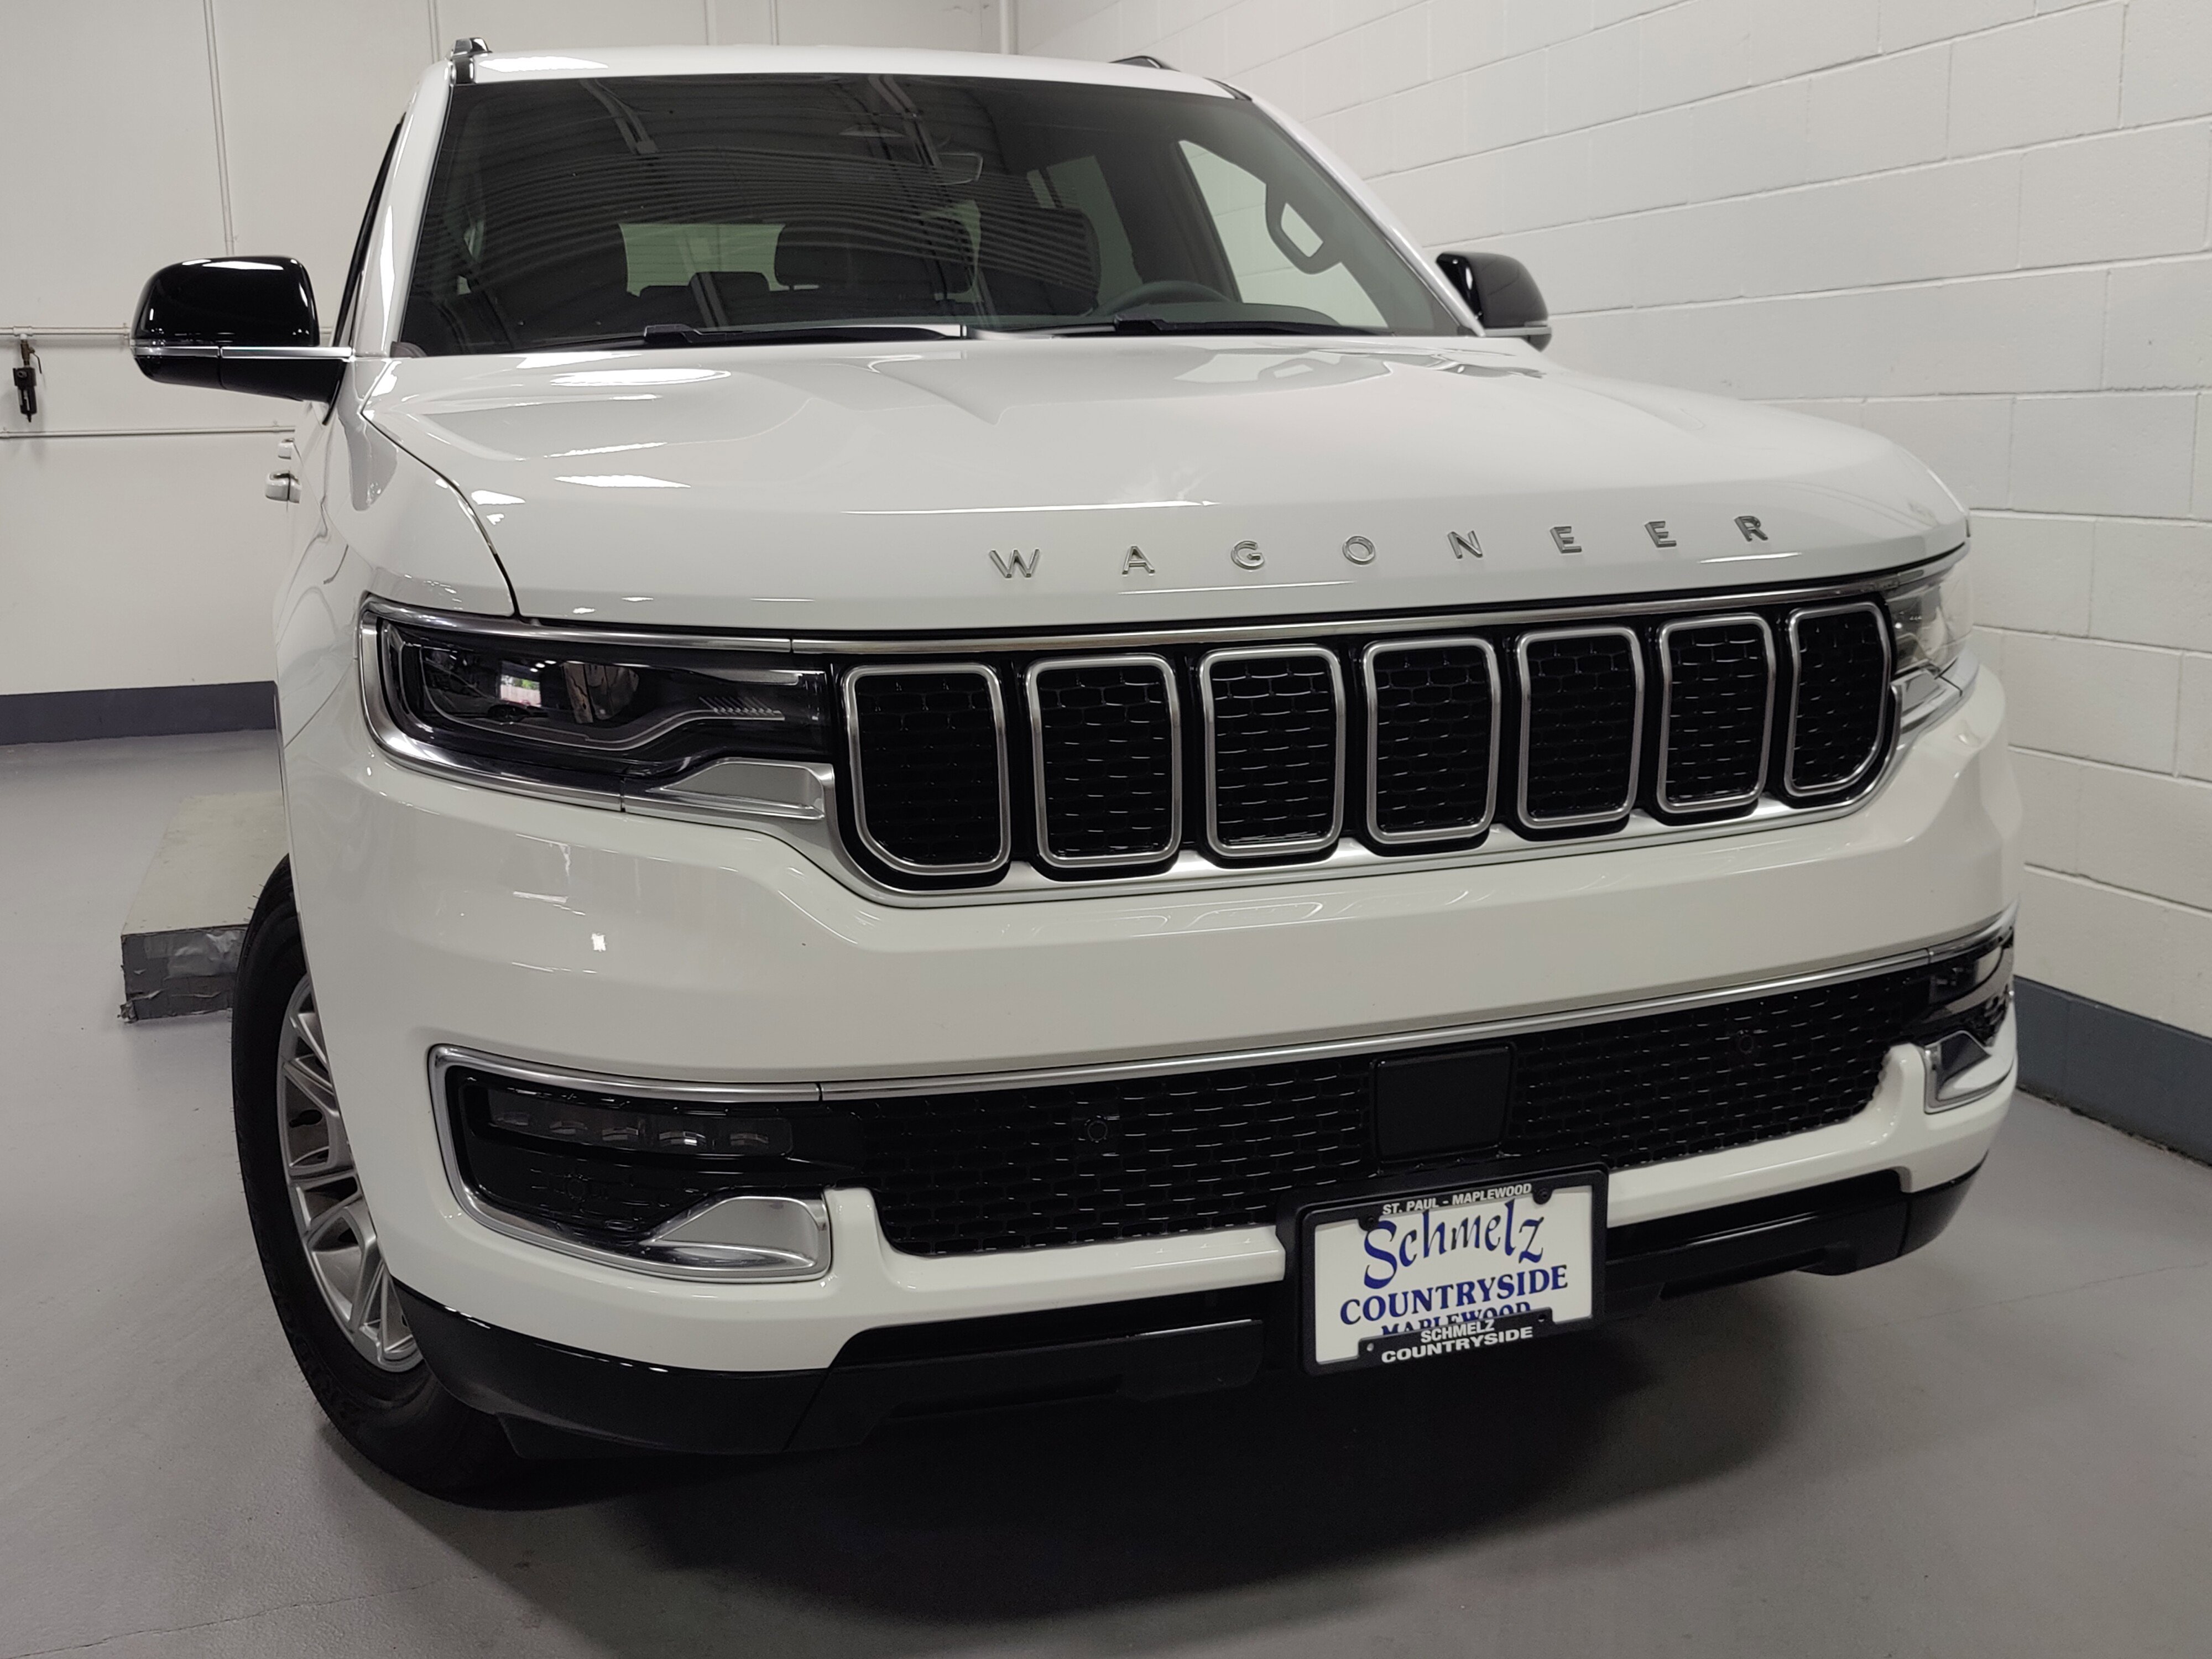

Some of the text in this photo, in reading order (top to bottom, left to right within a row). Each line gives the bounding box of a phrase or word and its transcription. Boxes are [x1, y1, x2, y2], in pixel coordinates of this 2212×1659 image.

[989, 515, 1768, 578] WAGONEER
[1382, 1203, 1402, 1215] ST.
[1406, 1197, 1439, 1212] PAUL
[1452, 1183, 1532, 1206] MAPLEWOOD
[1364, 1198, 1545, 1290] Schmelz
[1340, 1264, 1569, 1325] COUNTRYSIDE
[1381, 1326, 1533, 1363] COUNTRYSIDE
[1420, 1319, 1495, 1343] SCHMELZ
